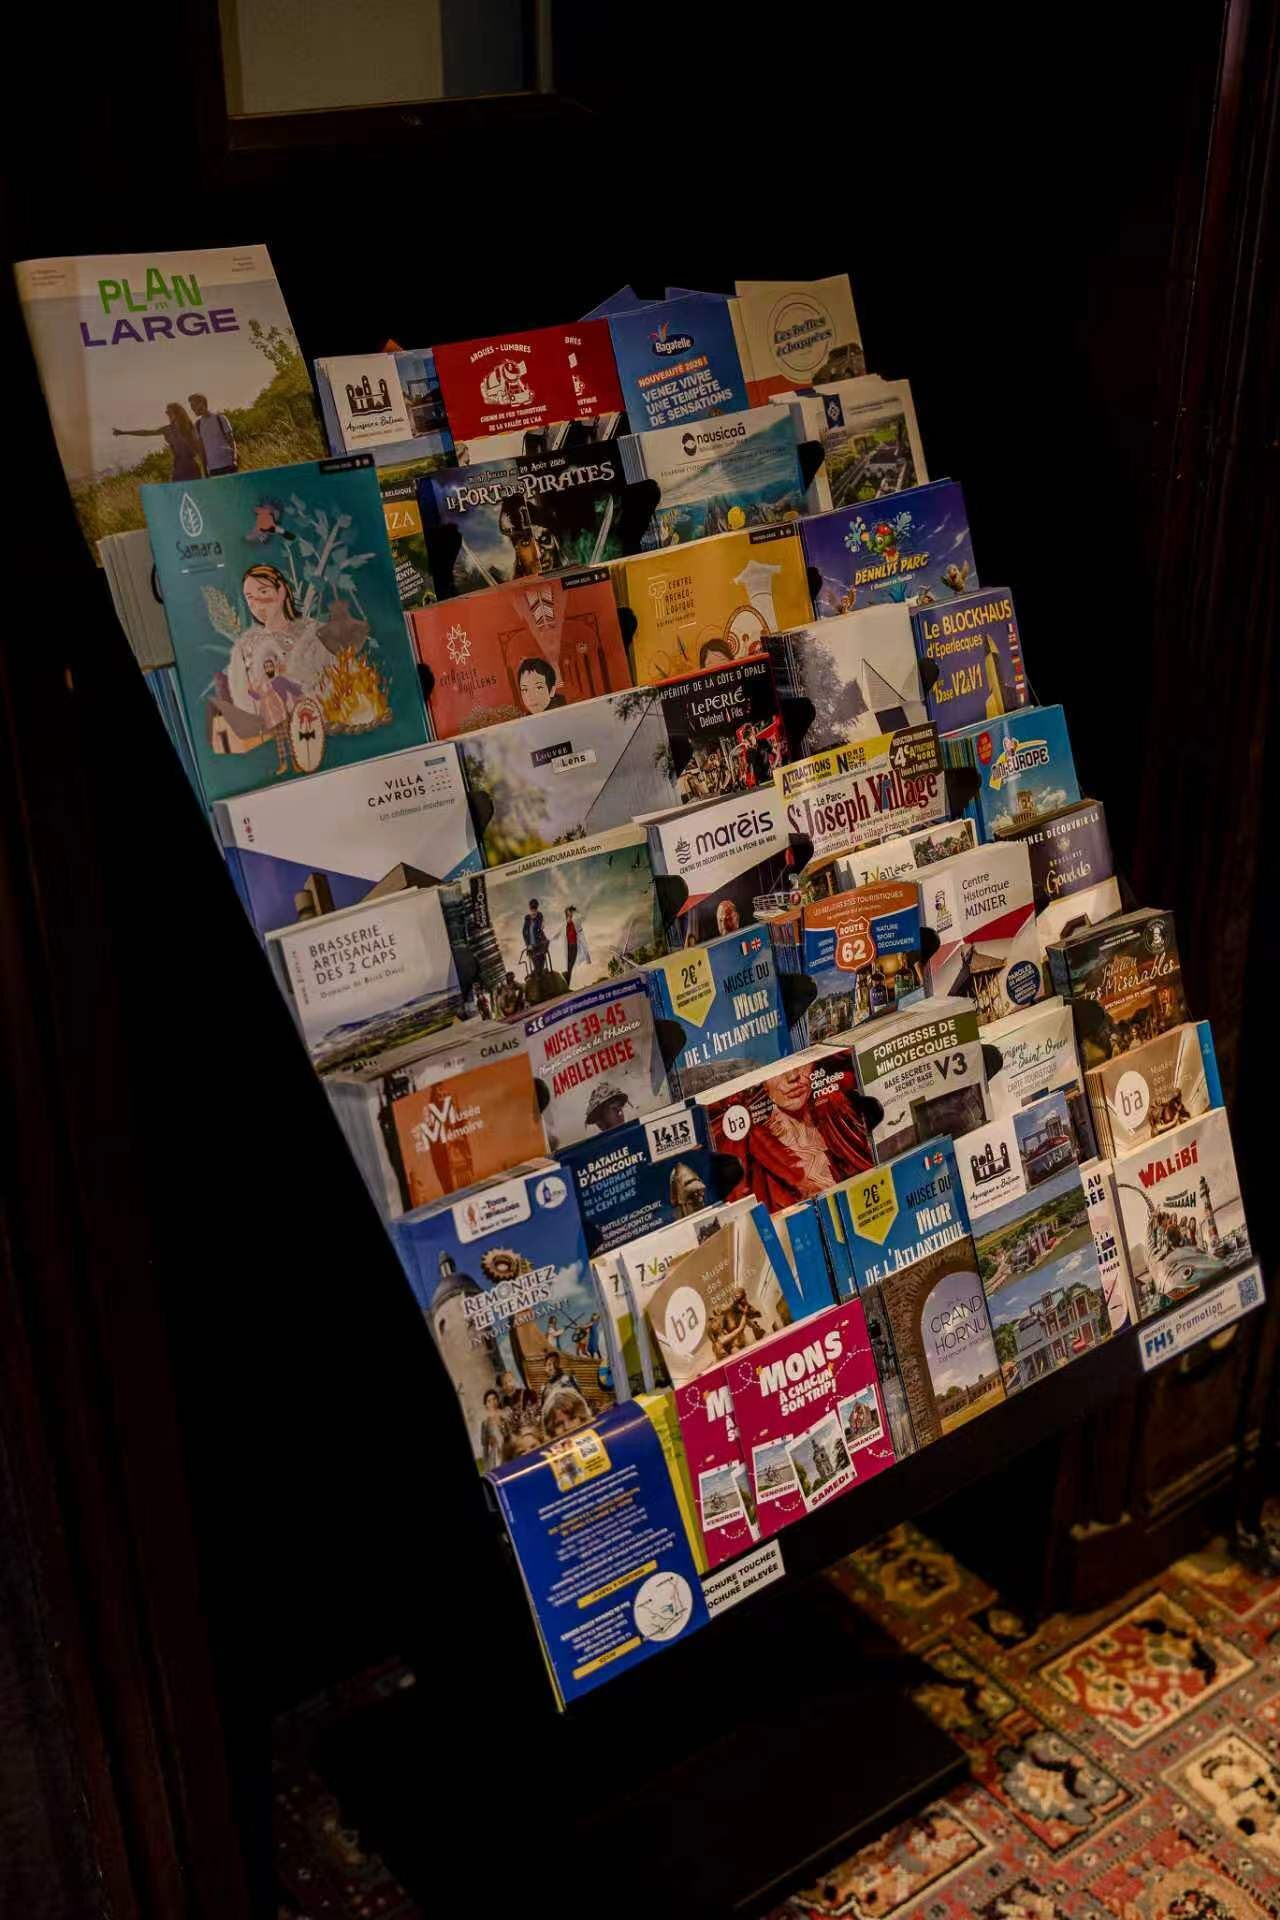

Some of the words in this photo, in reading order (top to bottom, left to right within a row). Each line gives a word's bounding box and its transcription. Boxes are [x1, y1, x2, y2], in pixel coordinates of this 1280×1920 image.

[97, 268, 204, 314] PLAN
[79, 308, 240, 347] LARGE
[500, 344, 532, 354] LUMBRES
[655, 336, 692, 355] Bagatelle
[638, 363, 684, 387] NOUVEAUTÉ
[643, 382, 678, 402] VENEZ
[681, 369, 713, 389] VIVRE
[646, 399, 670, 415] UNE
[672, 380, 721, 405] TEMPÊTE
[650, 413, 666, 426] DE
[668, 388, 733, 422] SENSATIONS
[456, 484, 502, 512] FORT
[504, 483, 525, 498] DES
[517, 461, 615, 499] PIRATES
[175, 540, 223, 562] Samara
[855, 558, 899, 586] DENNLYS
[899, 551, 930, 574] PARC
[667, 575, 693, 590] CENTRE
[924, 619, 941, 641] Le
[942, 599, 1013, 636] BLOCKHAUS
[659, 684, 691, 700] APÉRITIF
[692, 680, 703, 693] DE
[705, 677, 715, 690] LA
[717, 672, 736, 687] CÔTE
[561, 753, 587, 769] Lens
[385, 774, 424, 790] VILLA
[781, 757, 832, 796] ATTRACTIONS
[367, 785, 428, 809] CAVROIS
[423, 797, 456, 812] moderne
[803, 781, 871, 838] Joseph
[866, 767, 938, 814] Village
[1090, 812, 1100, 823] LA
[679, 863, 696, 875] CENTRE
[735, 843, 742, 853] LA
[758, 837, 766, 847] EN
[766, 833, 777, 844] MER
[859, 871, 870, 885] 7
[961, 871, 991, 891] Centre
[963, 879, 1010, 903] Historique
[965, 893, 1009, 920] MINIER
[308, 924, 382, 959] BRASSERIE
[840, 921, 865, 936] ROUTE
[313, 933, 398, 972] ARTISANALE
[841, 939, 868, 963] 62
[316, 965, 344, 985] DES
[348, 961, 358, 975] 2
[361, 948, 398, 970] CAPS
[755, 961, 770, 980] DU
[581, 1002, 626, 1039] 39-45
[480, 1036, 519, 1058] CALAIS
[872, 1025, 937, 1062] FORTERESSE
[938, 1019, 957, 1033] DE
[552, 1038, 635, 1099] AMBLETEUSE
[684, 1048, 701, 1070] DE
[876, 1034, 959, 1077] MIMOYECQUES
[884, 1076, 901, 1090] BASE
[933, 1053, 968, 1080] V3
[917, 1071, 934, 1085] BASE
[812, 1083, 841, 1100] mode
[652, 1120, 691, 1147] 1415
[656, 1135, 692, 1154] AZINCOURT
[577, 1167, 588, 1178] LA
[587, 1145, 630, 1174] BATAILLE
[590, 1165, 638, 1194] TOURNANT
[603, 1176, 637, 1200] GUERRE
[938, 1174, 952, 1193] DU
[1087, 1173, 1102, 1190] AU
[595, 1196, 618, 1214] CENT
[618, 1187, 638, 1204] ANS
[628, 1218, 645, 1233] POINT
[609, 1273, 620, 1294] 7
[635, 1261, 646, 1283] 7
[864, 1265, 882, 1288] DE
[464, 1265, 554, 1315] REMONTEZ
[474, 1312, 493, 1329] LE
[496, 1285, 550, 1318] TEMPS
[929, 1294, 984, 1335] GRAND
[1175, 1300, 1224, 1334] Promotion
[935, 1316, 988, 1356] HORNU
[758, 1330, 844, 1398] MONS
[778, 1387, 788, 1406] À
[787, 1368, 834, 1399] CHACUN
[780, 1398, 807, 1418] SON
[760, 1482, 796, 1500] VENDREDI
[810, 1472, 851, 1508] SAMEDI
[706, 1509, 742, 1527] VENDREDI
[737, 1549, 777, 1577] TOUCHÉE
[742, 1562, 779, 1590] ENLEVÉE
